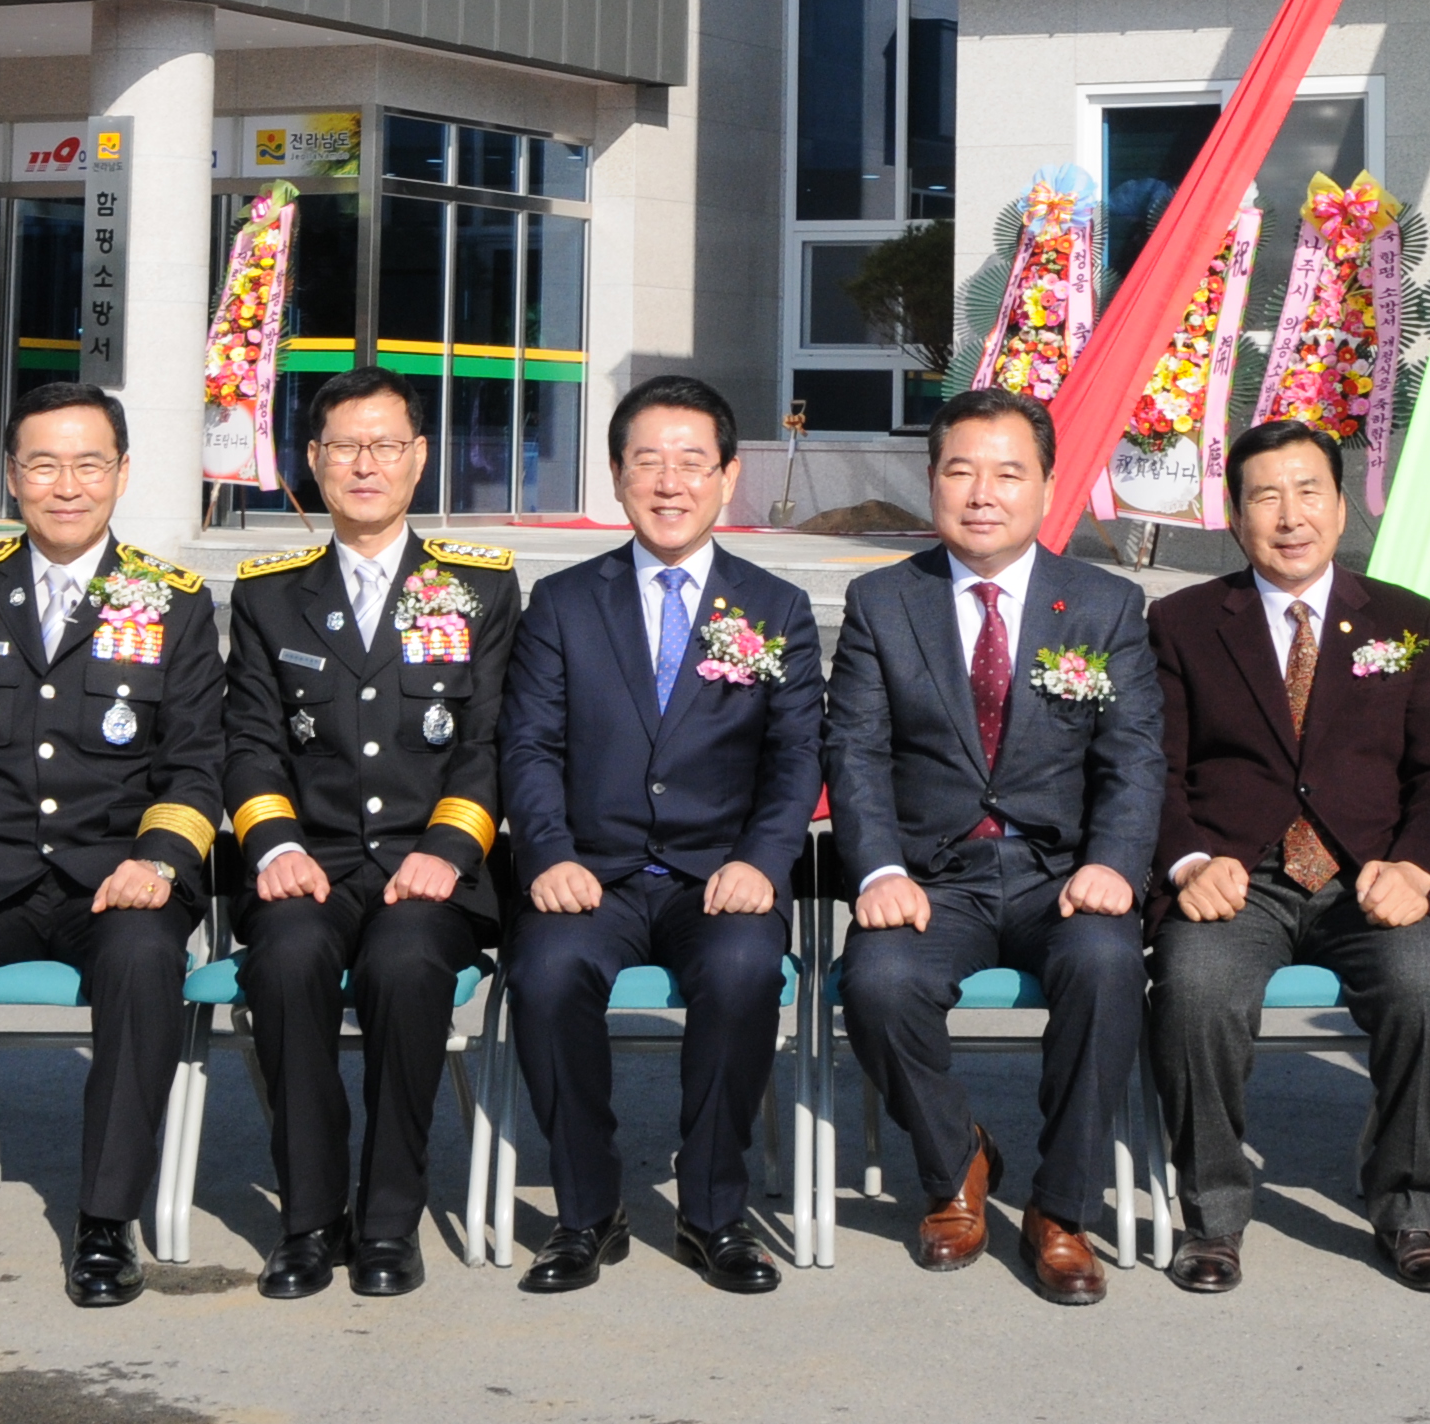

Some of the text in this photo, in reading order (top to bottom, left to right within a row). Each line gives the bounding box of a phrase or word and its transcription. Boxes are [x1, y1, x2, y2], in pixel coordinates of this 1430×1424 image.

[289, 131, 351, 151] 전라남도
[89, 190, 118, 362] 함평소방서
[1290, 234, 1322, 303] 나주시
[1370, 398, 1392, 469] 축하합니다
